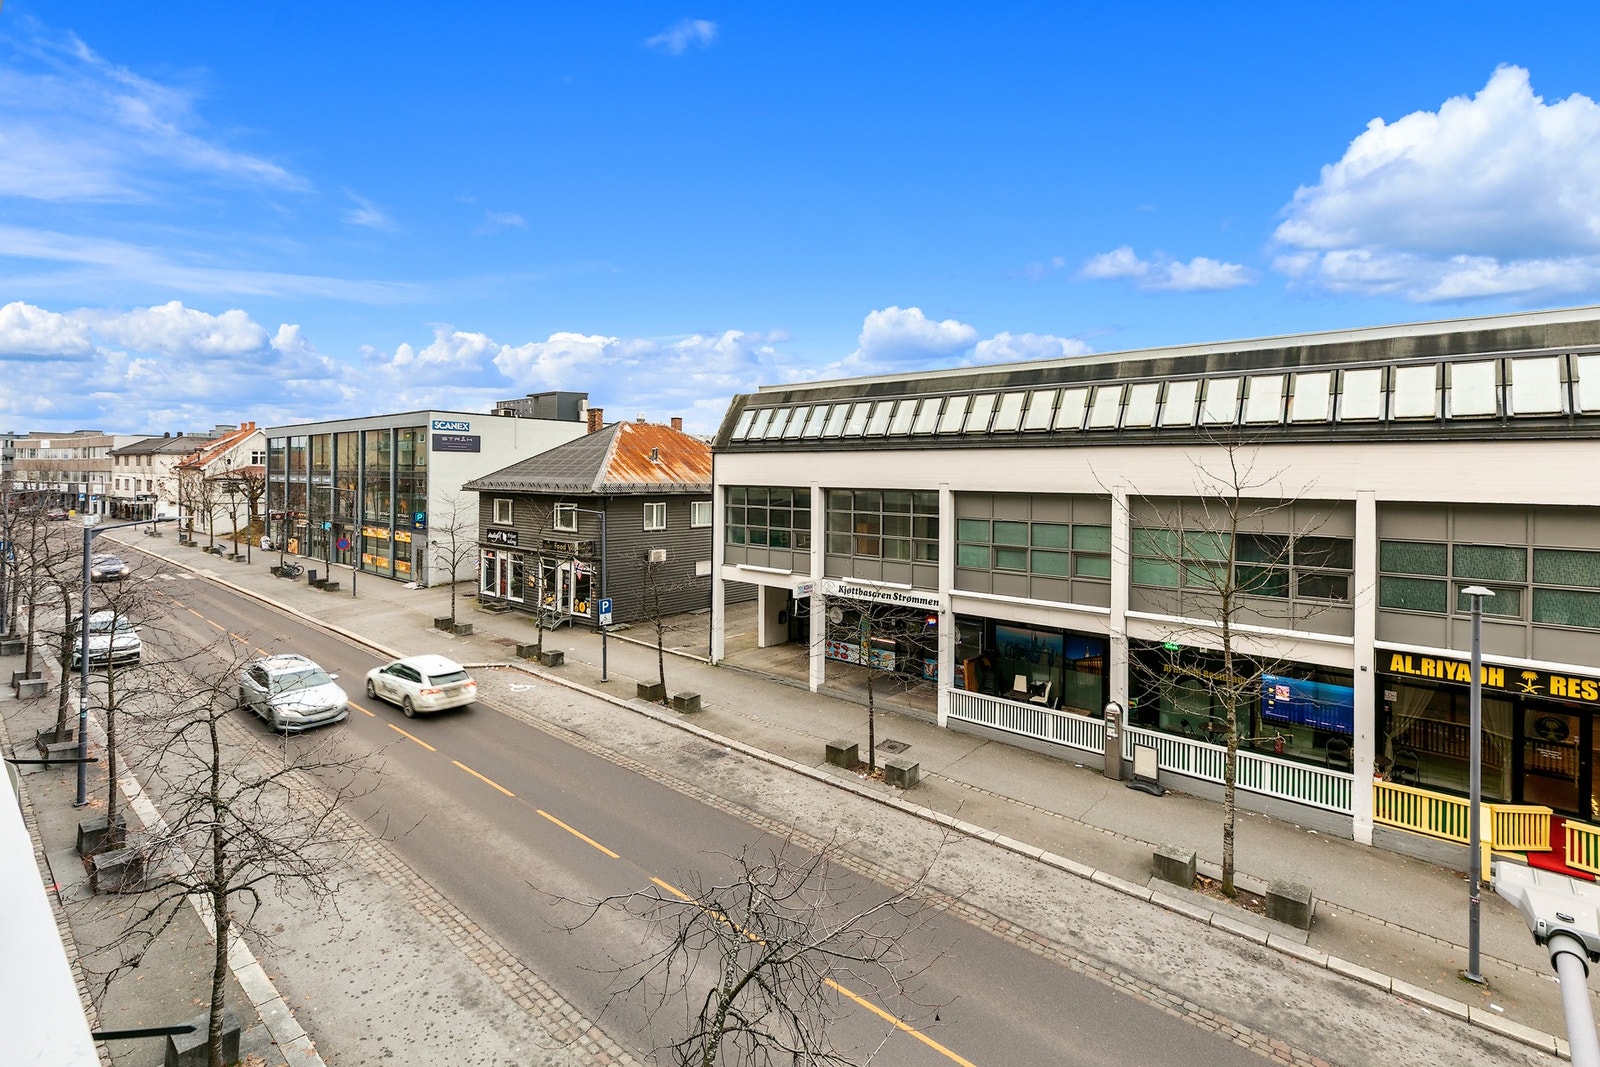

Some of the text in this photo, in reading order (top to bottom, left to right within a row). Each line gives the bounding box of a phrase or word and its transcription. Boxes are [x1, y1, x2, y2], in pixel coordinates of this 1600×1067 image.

[434, 421, 469, 431] SCANEX
[838, 585, 940, 606] Kjøttbasaren Strømmen
[602, 601, 609, 613] P
[1550, 675, 1600, 701] RES
